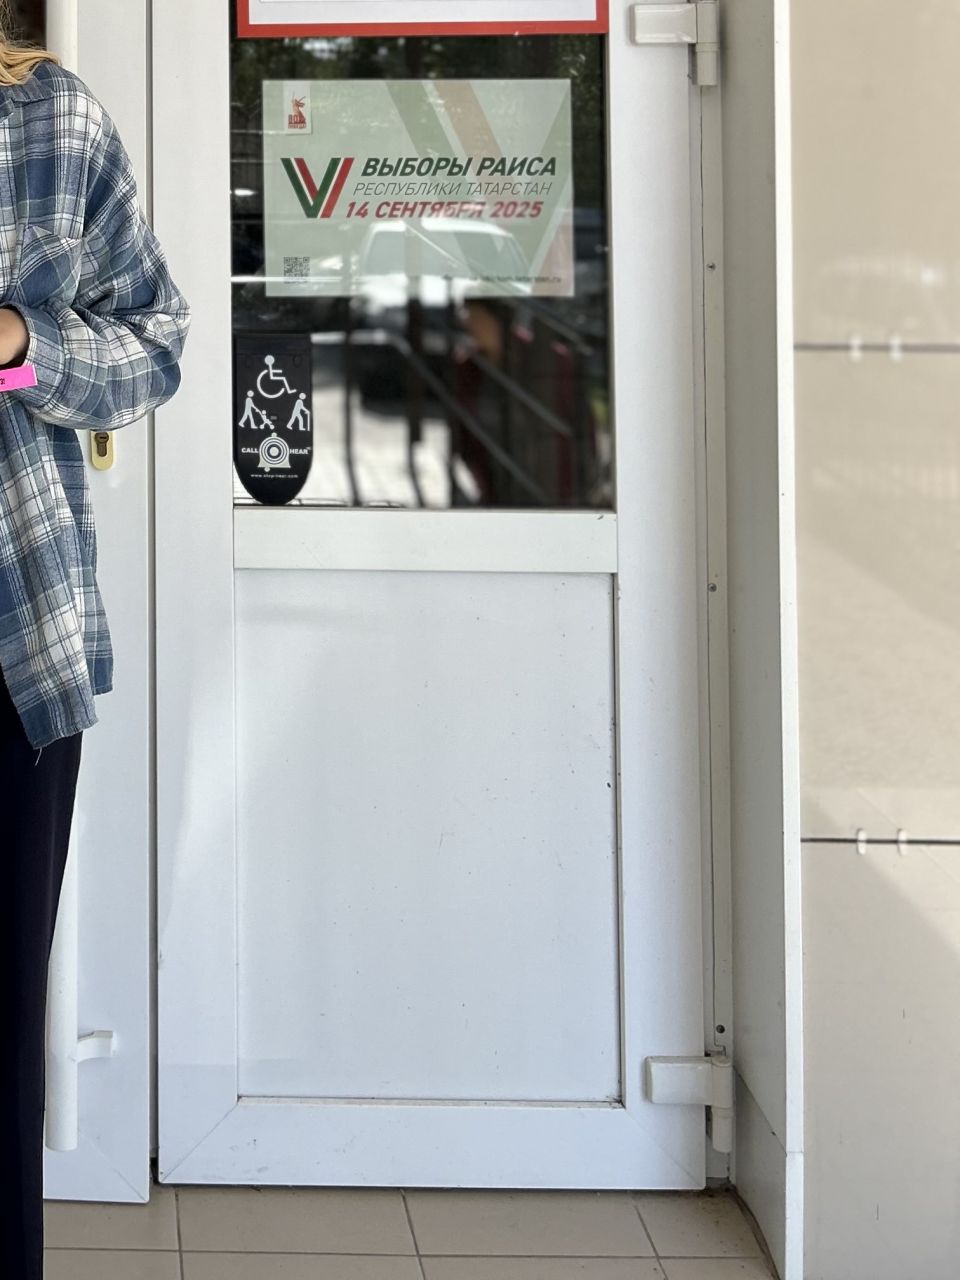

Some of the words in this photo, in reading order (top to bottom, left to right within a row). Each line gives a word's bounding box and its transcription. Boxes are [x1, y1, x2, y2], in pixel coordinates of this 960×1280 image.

[361, 157, 473, 177] ВЫБОРЫ
[475, 157, 556, 176] РАИСА
[353, 181, 462, 196] РЕСПУБЛИКИ
[465, 181, 552, 196] ТАТАРСТАН
[346, 201, 369, 218] 14
[375, 201, 487, 218] СЕНТЯБРЯ
[490, 201, 544, 218] 2025
